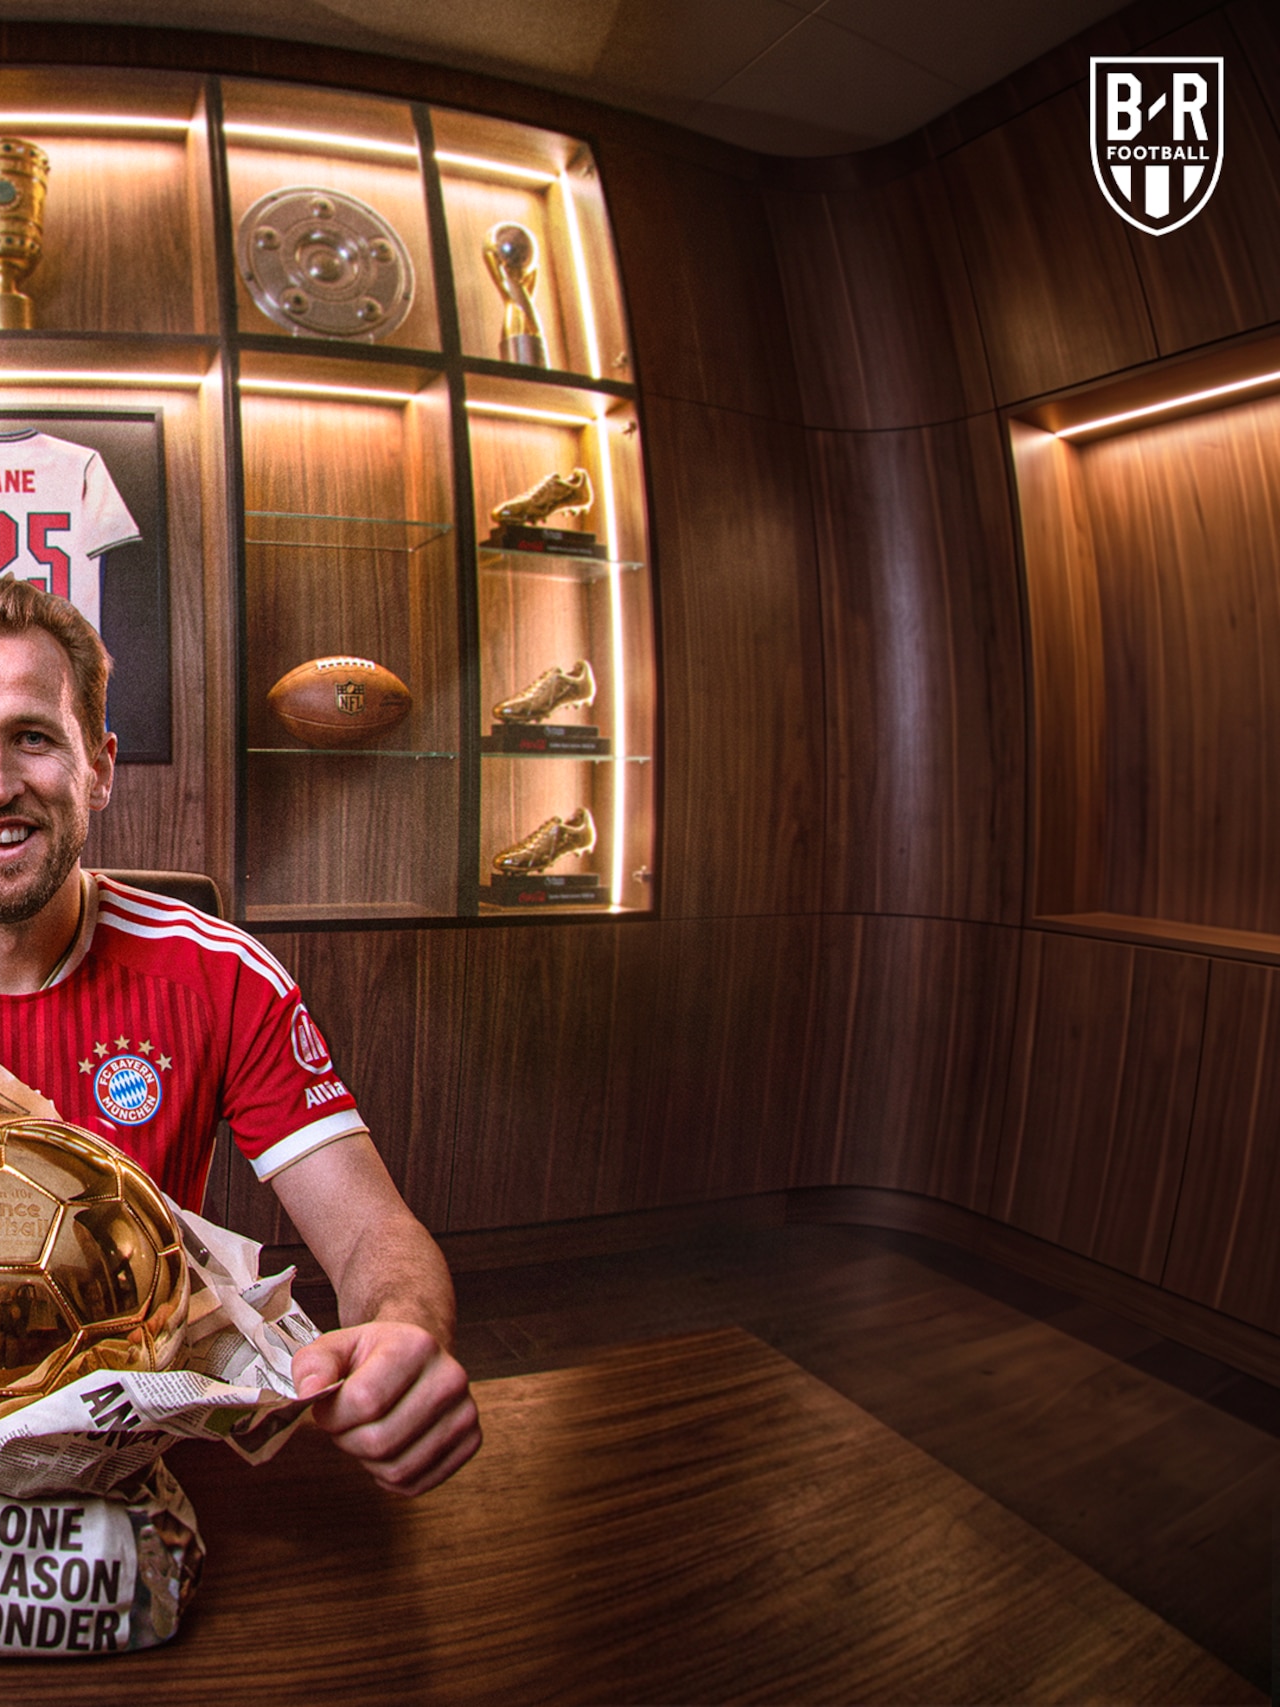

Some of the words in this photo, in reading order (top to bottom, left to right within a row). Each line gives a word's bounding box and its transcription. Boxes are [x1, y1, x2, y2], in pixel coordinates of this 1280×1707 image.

[339, 695, 364, 712] NFL
[99, 1069, 112, 1086] FC
[110, 1059, 155, 1084] BAYERN
